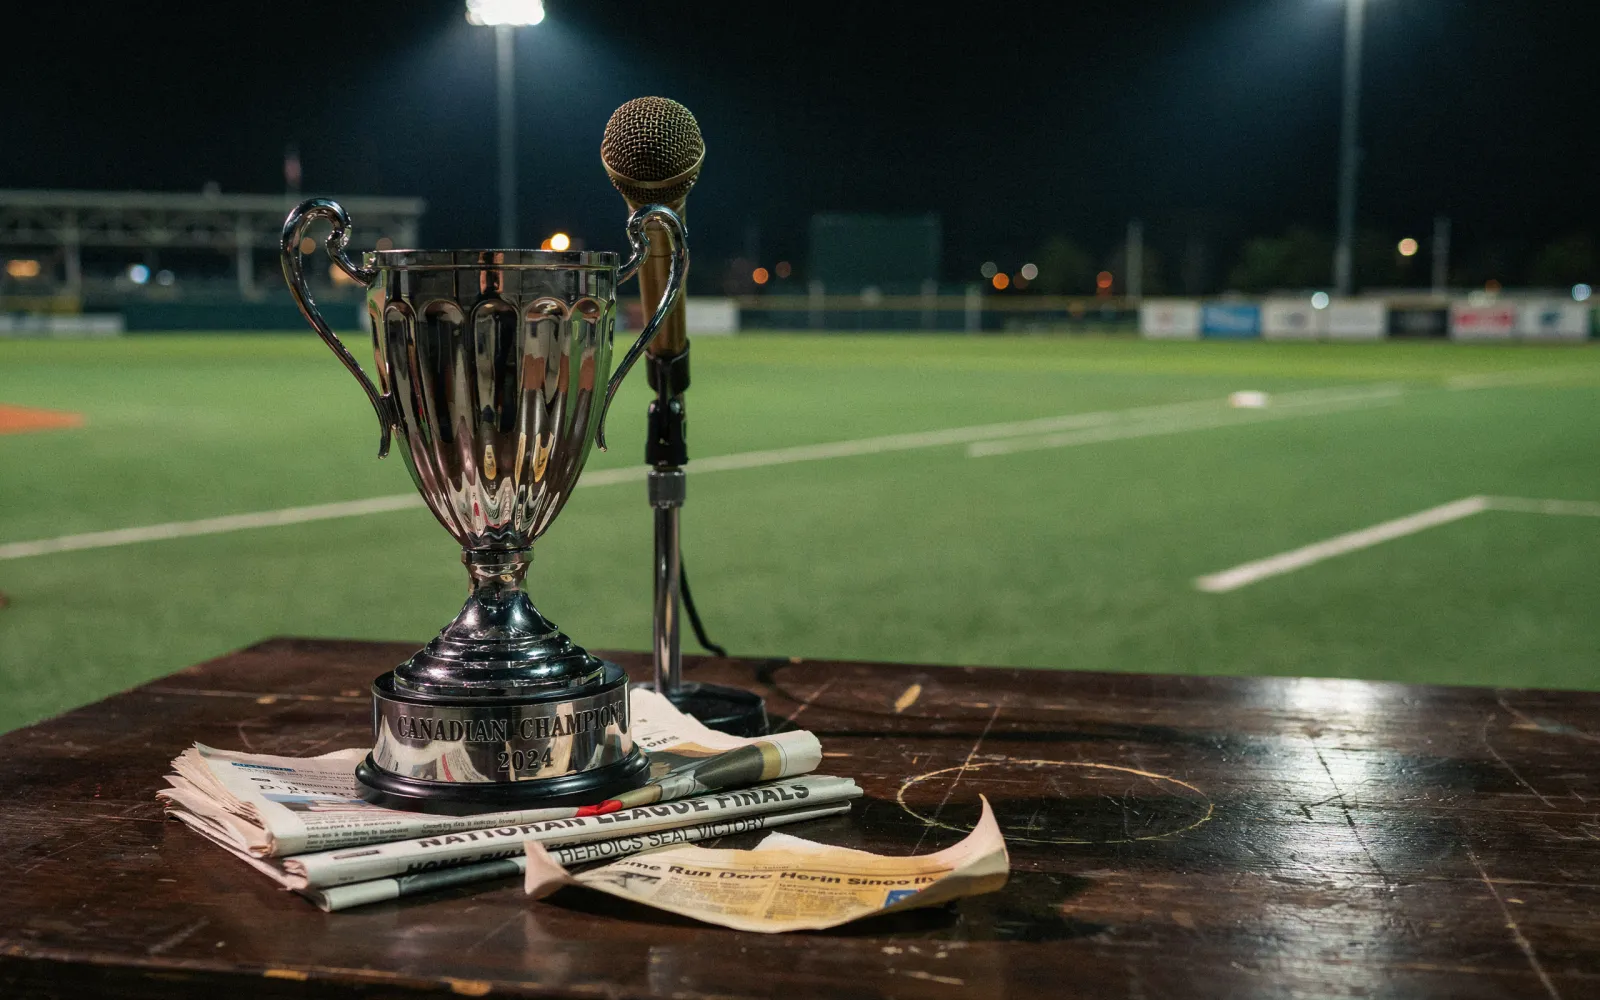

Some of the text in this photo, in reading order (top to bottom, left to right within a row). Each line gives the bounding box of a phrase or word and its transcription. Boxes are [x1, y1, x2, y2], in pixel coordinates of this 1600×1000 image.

[397, 715, 507, 743] CANADIAN
[497, 749, 554, 772] 2024
[596, 799, 710, 824] LEAGUE
[715, 784, 810, 809] FINALS
[558, 834, 643, 863] HEROICS
[648, 826, 694, 847] SEAL
[695, 815, 766, 839] VICTORY
[668, 865, 712, 877] Run
